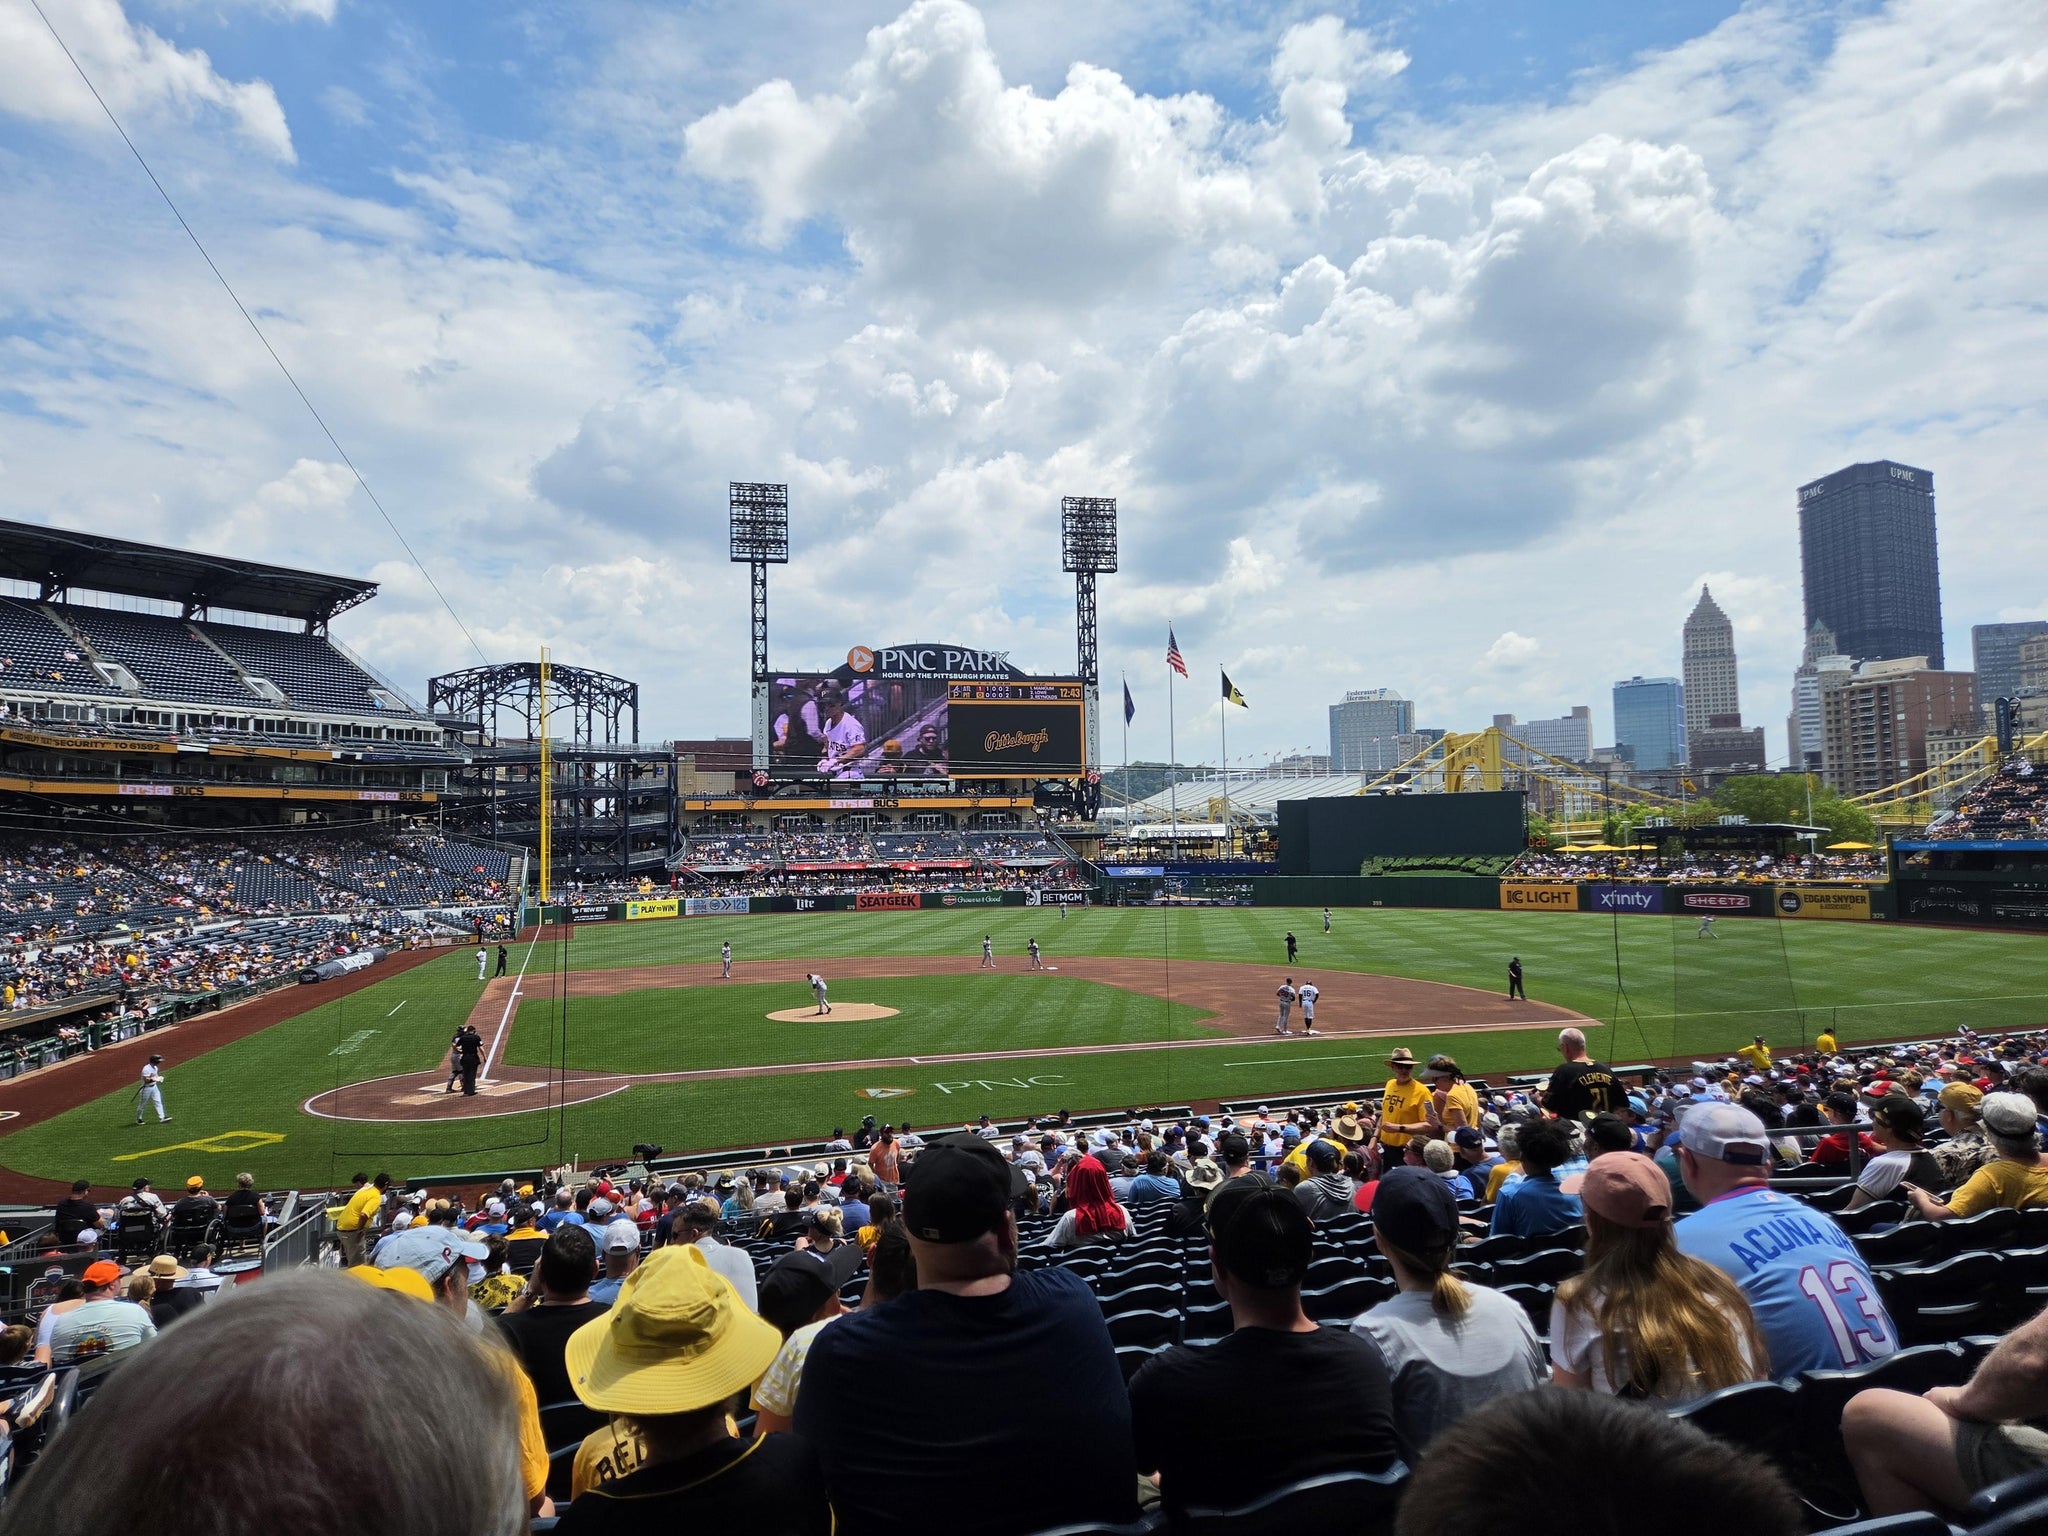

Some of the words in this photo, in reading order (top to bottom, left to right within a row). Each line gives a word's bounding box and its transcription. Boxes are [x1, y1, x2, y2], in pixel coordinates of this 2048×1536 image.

[1890, 467, 1915, 482] UPMC
[879, 649, 937, 671] PNC
[942, 650, 1010, 671] PARK
[1059, 688, 1081, 698] 12:43
[984, 727, 1049, 753] Pittsburgh
[114, 742, 128, 750] TO
[129, 742, 161, 751] 61592
[118, 785, 154, 796] LET'S
[173, 786, 204, 796] BUCS
[358, 791, 385, 800] LET'S
[399, 792, 423, 801] BUCS
[873, 799, 899, 808] BUCS
[1717, 814, 1746, 826] TIME
[1124, 867, 1148, 875] Ford
[859, 895, 916, 908] SEATGEEK
[1042, 893, 1082, 902] BETMGM
[1526, 891, 1571, 904] LIGHT
[1600, 890, 1653, 909] xfinity
[1688, 896, 1747, 906] SHEETZ
[1803, 894, 1832, 904] EDGAR
[1832, 895, 1867, 905] SNYDER
[640, 905, 656, 914] PLAY
[662, 904, 677, 912] WIN!
[733, 898, 747, 910] 125
[796, 898, 815, 910] Lite
[929, 1075, 1076, 1094] PNC
[1578, 1072, 1612, 1086] CLEMENTE
[1383, 1094, 1406, 1108] PGH
[1590, 1087, 1609, 1111] 21
[1729, 1213, 1830, 1273] ACUÑA
[442, 1245, 452, 1264] P
[1797, 1260, 1897, 1367] 13
